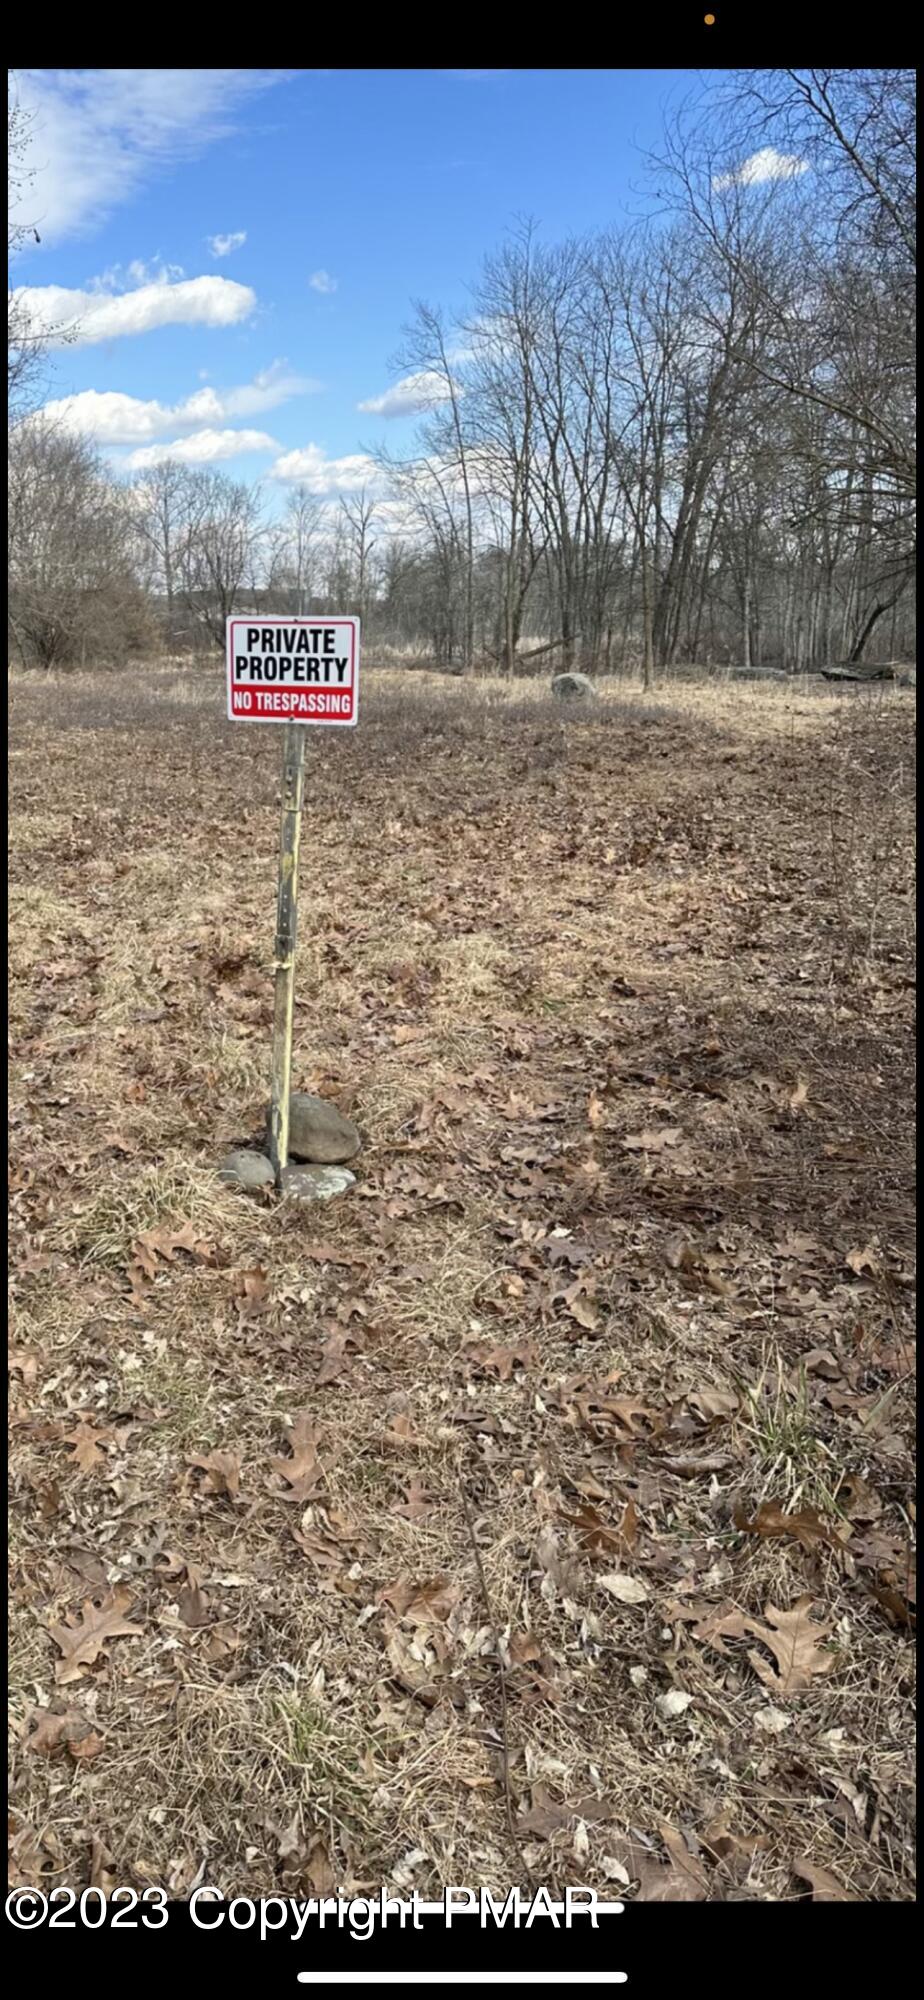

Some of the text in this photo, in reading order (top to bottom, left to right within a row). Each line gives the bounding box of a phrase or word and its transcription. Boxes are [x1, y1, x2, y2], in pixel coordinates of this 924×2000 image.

[247, 628, 336, 654] PRIVATE
[235, 656, 348, 682] PROPERTY
[233, 691, 351, 713] NO TRESPASSING
